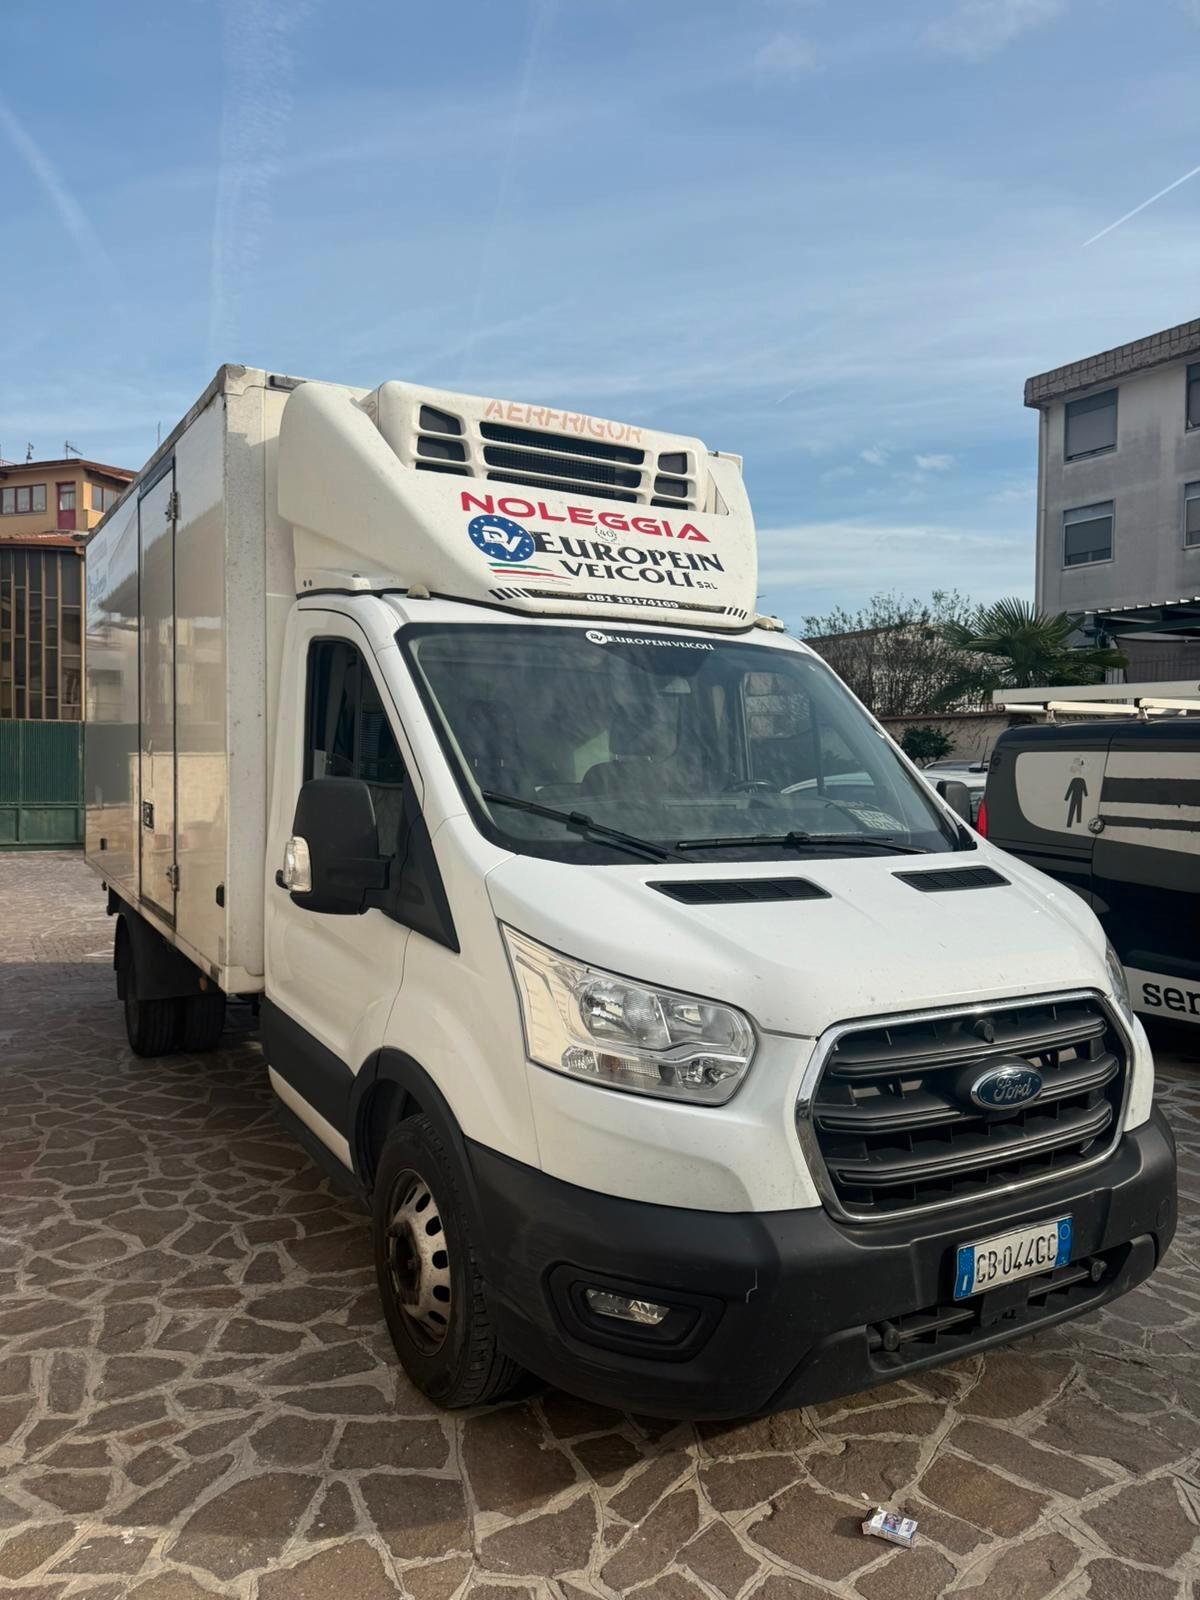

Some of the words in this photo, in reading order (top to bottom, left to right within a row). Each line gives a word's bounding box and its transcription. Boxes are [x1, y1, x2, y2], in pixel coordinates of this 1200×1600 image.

[485, 399, 643, 444] AERFRIGOR
[460, 491, 711, 543] NOLEGGIA
[531, 531, 725, 573] EUROPEIN
[559, 560, 694, 588] VEICOLI
[696, 580, 719, 590] SRL
[586, 593, 613, 604] 081
[616, 596, 680, 609] 19174169
[992, 1073, 1034, 1100] Ford
